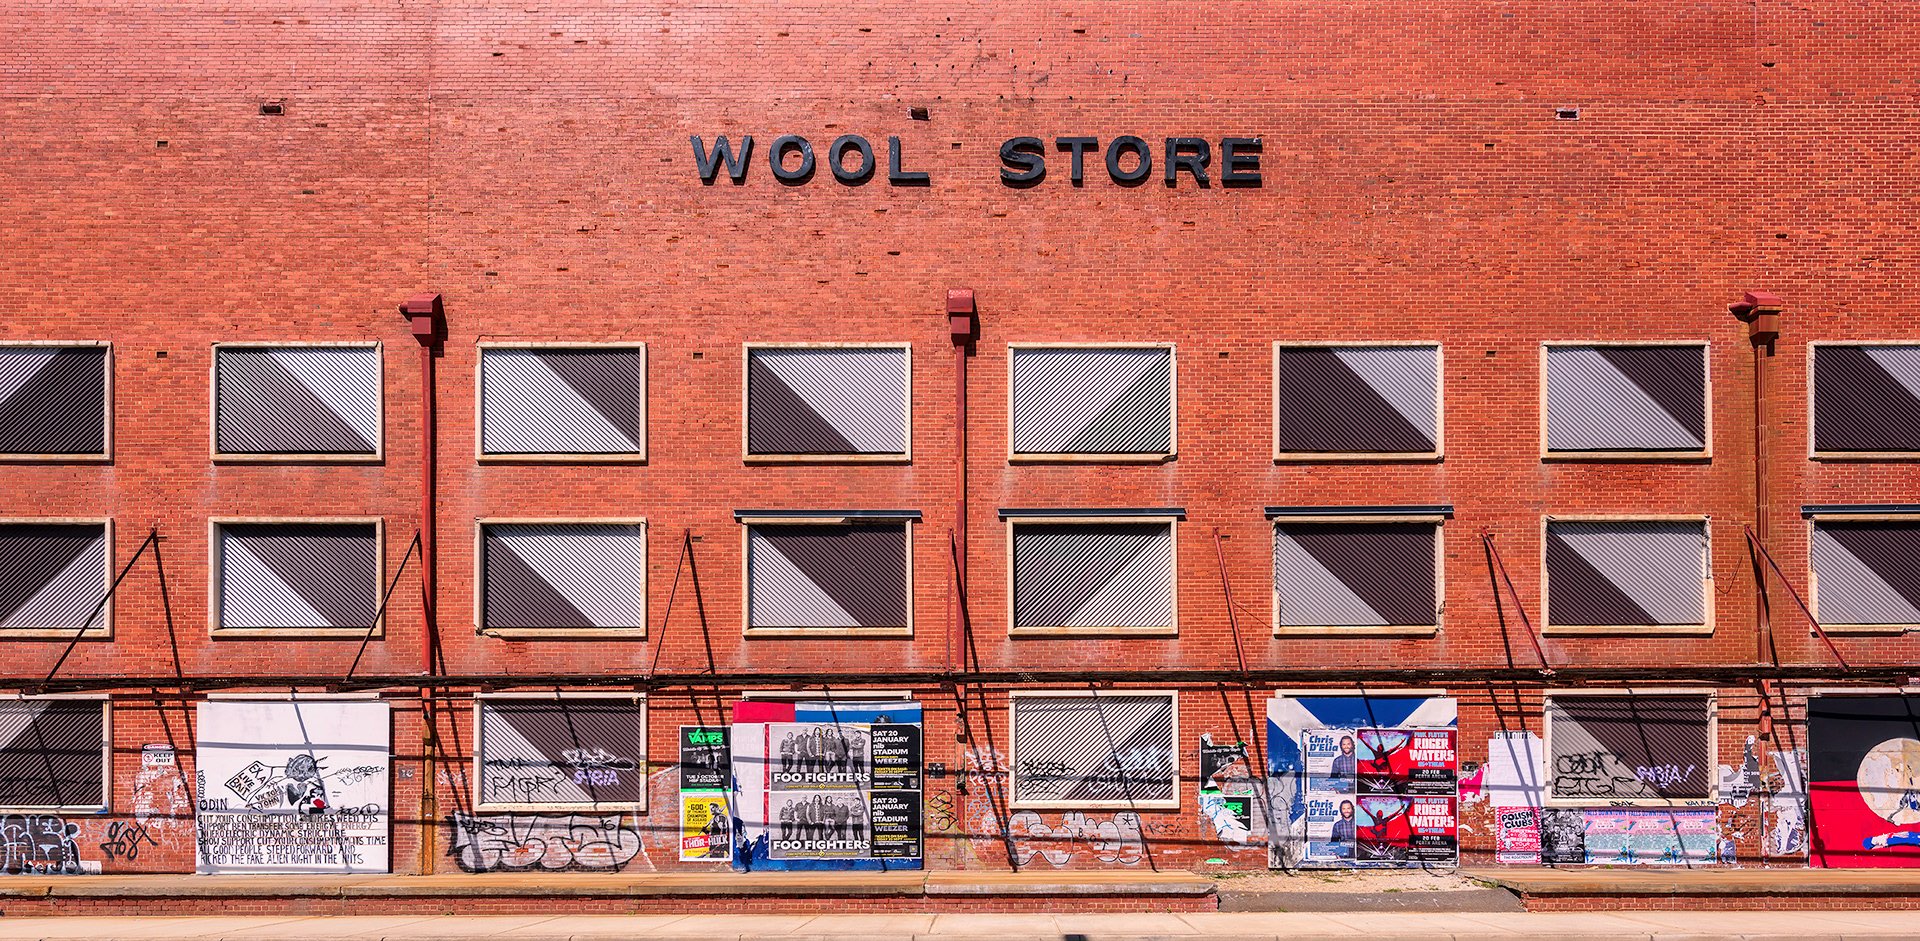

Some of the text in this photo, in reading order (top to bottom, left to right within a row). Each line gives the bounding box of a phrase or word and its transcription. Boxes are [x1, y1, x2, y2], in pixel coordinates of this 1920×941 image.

[690, 135, 1263, 188] WOOL STORE
[688, 728, 724, 744] VAMPS
[1309, 735, 1334, 743] Chris
[1310, 742, 1338, 751] D'Elia
[1414, 738, 1448, 749] ROGER
[1409, 750, 1454, 761] WATERS
[238, 772, 255, 788] LIVE
[774, 773, 802, 782] FOO
[805, 773, 870, 782] FIGHTERS
[1309, 800, 1333, 808] Chris
[1310, 807, 1338, 816] D'Elia
[1414, 804, 1448, 815] ROGER
[198, 814, 214, 822] CUT
[216, 814, 234, 822] YOUR
[236, 814, 297, 822] CONSUMPTION
[336, 814, 359, 822] WEED
[1409, 816, 1454, 827] WATERS
[1502, 811, 1533, 822] POLISH
[600, 819, 616, 830] 16
[1504, 820, 1533, 828] CLUBS
[366, 837, 386, 845] TIME
[773, 840, 802, 849] FOO
[804, 840, 870, 850] FIGHTERS
[213, 845, 235, 854] GOOD
[236, 845, 263, 854] PEOPLE
[297, 845, 333, 854] FORWARD
[338, 845, 356, 854] AND
[232, 855, 244, 864] THE
[247, 855, 264, 864] FAKE
[267, 855, 288, 864] ALIEN
[291, 855, 312, 864] RIGHT
[324, 855, 338, 864] THE
[342, 854, 364, 864] NUTS
